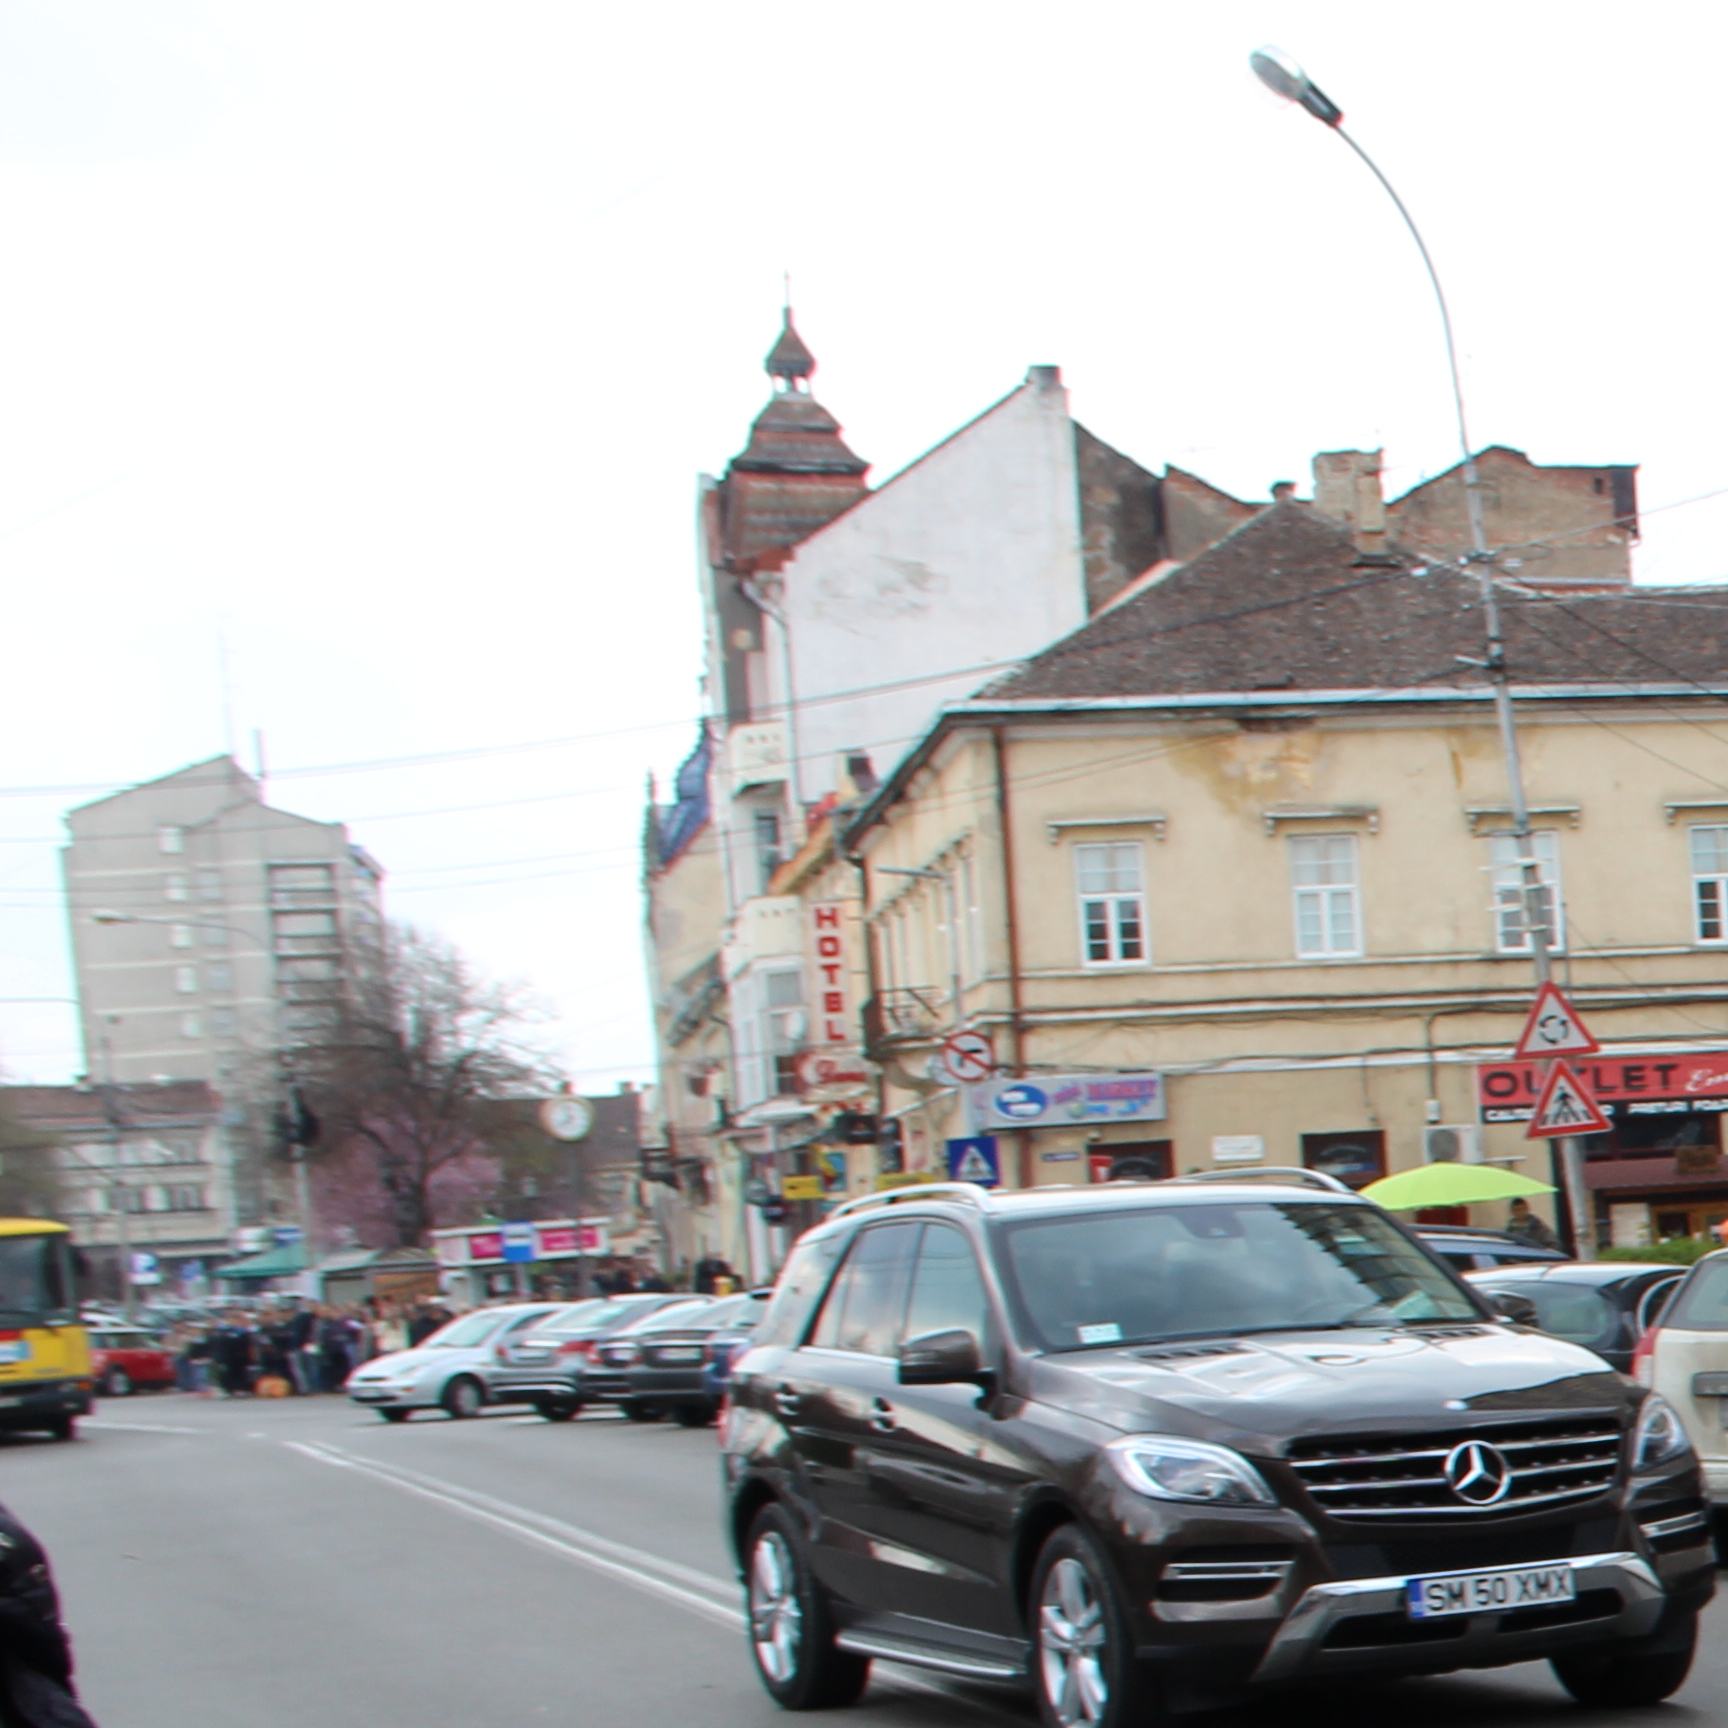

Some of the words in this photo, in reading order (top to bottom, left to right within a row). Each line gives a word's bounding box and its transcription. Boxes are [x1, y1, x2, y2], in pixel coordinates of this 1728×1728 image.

[815, 907, 847, 1041] HOTEL
[1426, 1578, 1469, 1611] SM
[1474, 1577, 1508, 1606] 50
[1516, 1568, 1569, 1602] XMX
